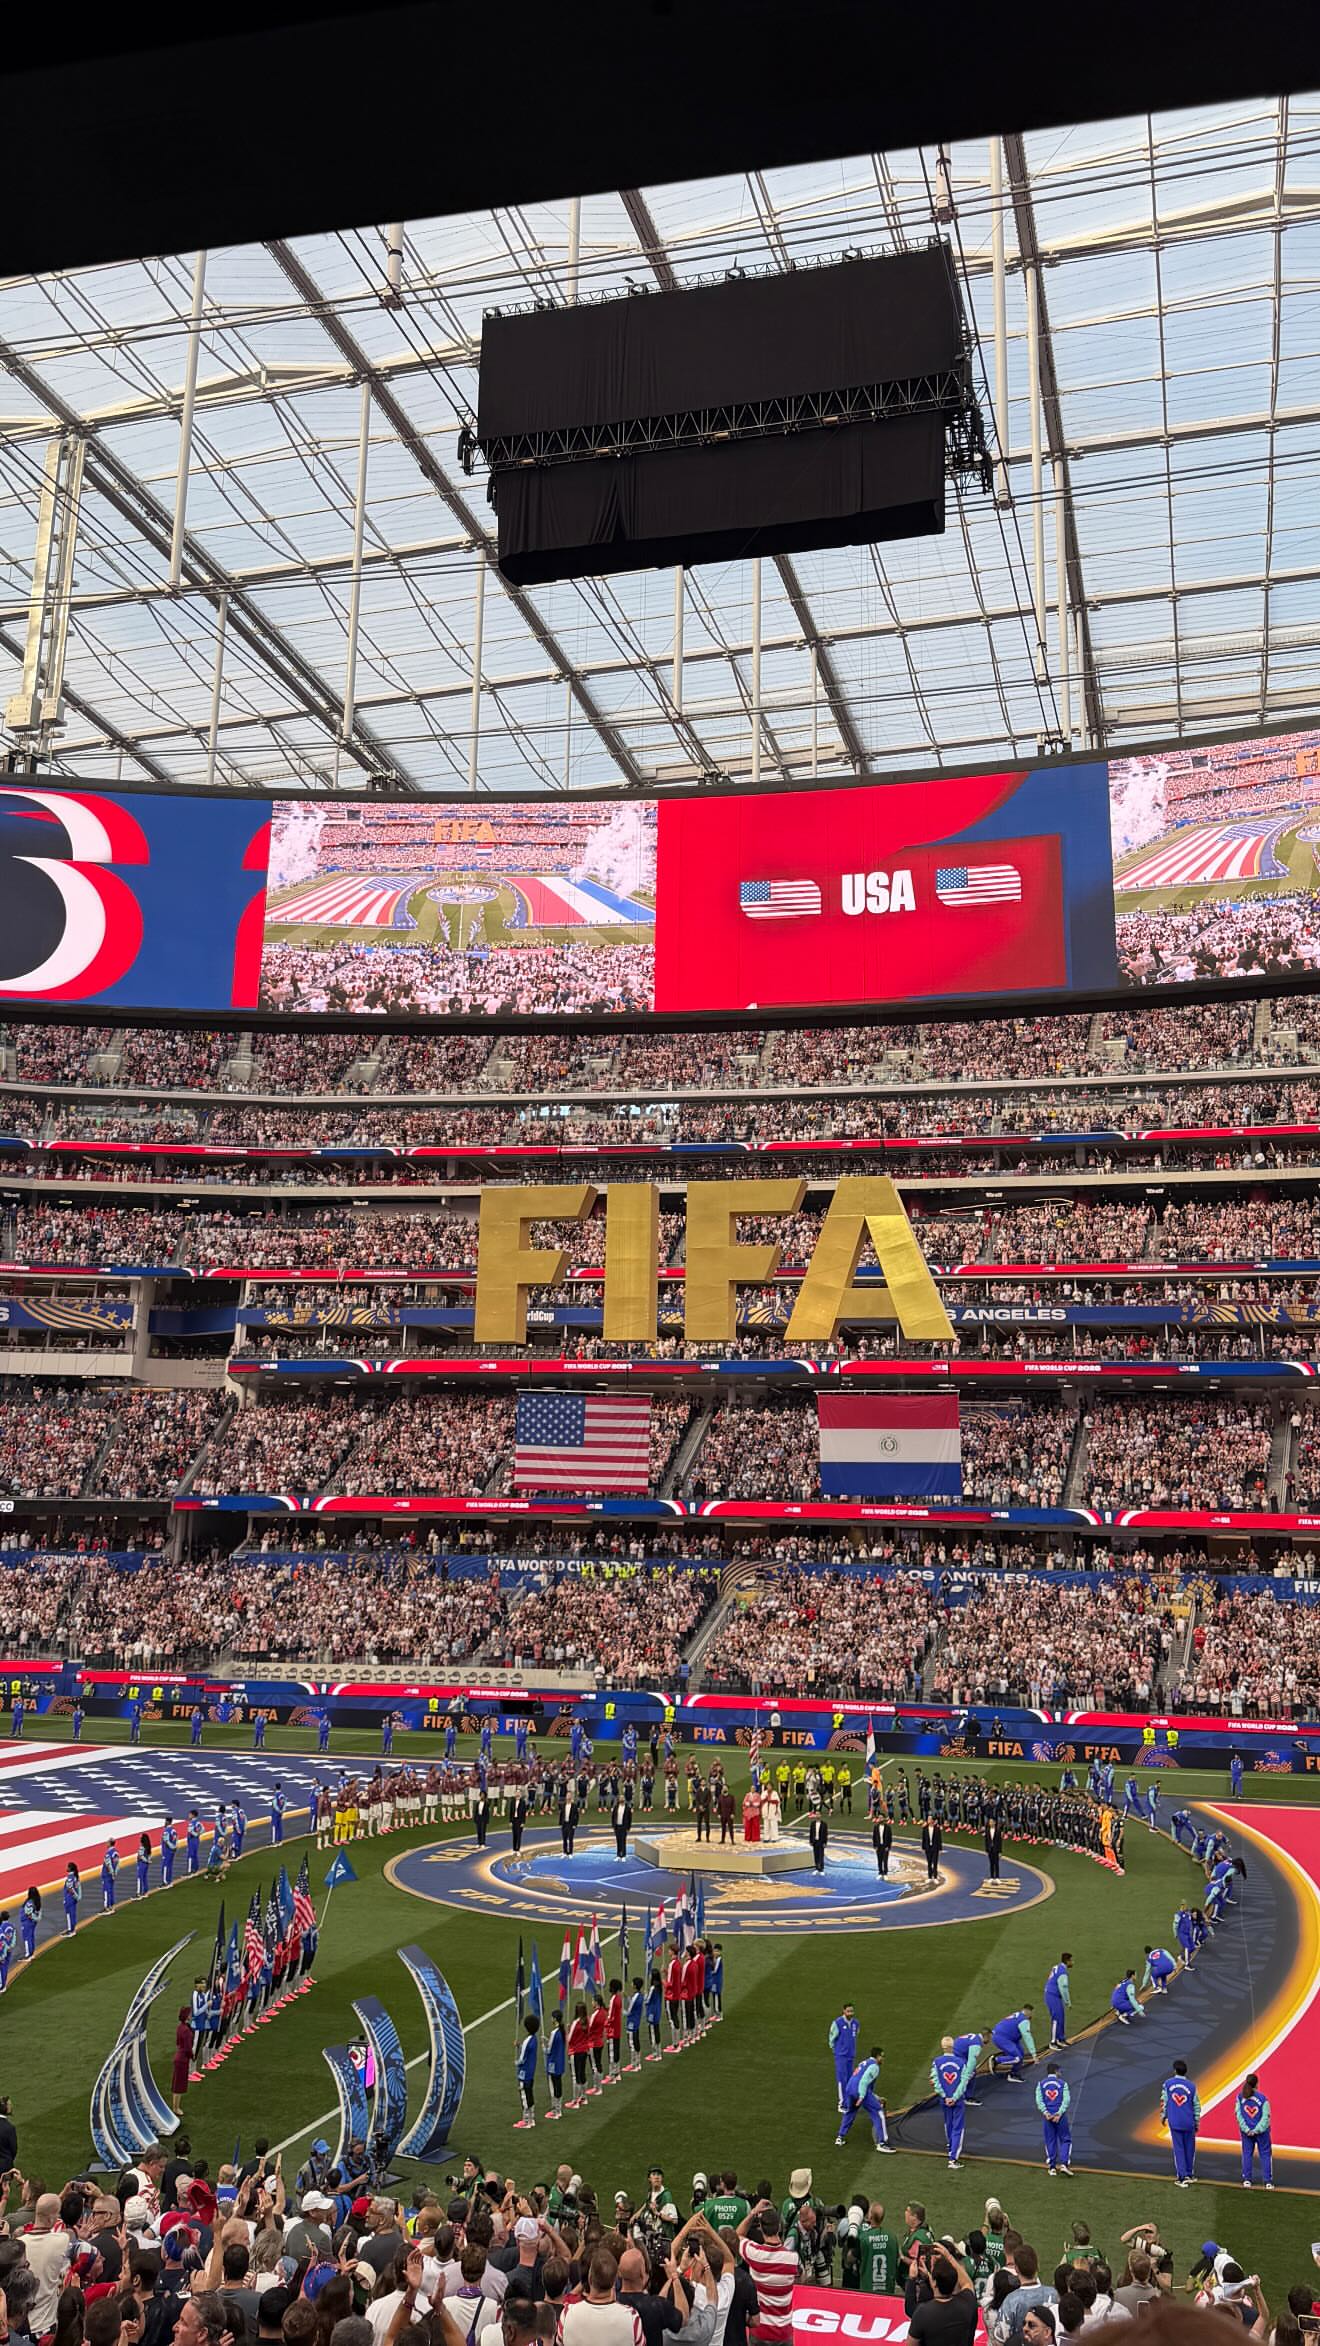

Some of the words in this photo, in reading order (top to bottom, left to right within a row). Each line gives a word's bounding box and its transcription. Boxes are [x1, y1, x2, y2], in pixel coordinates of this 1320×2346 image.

[435, 820, 497, 842] FIFA
[841, 869, 916, 916] USA
[474, 1176, 957, 1345] FIFA
[961, 1308, 1067, 1321] ANGELES
[423, 1715, 453, 1729] FIFA
[693, 1726, 727, 1742] FIFA
[782, 1731, 816, 1746] FIFA
[988, 1740, 1024, 1757] FIFA
[449, 1887, 511, 1905] FIFA
[509, 1901, 641, 1922] WORLD
[739, 1915, 882, 1927] 2026
[714, 2204, 738, 2213] PHOTO
[868, 2234, 889, 2243] PHOTO
